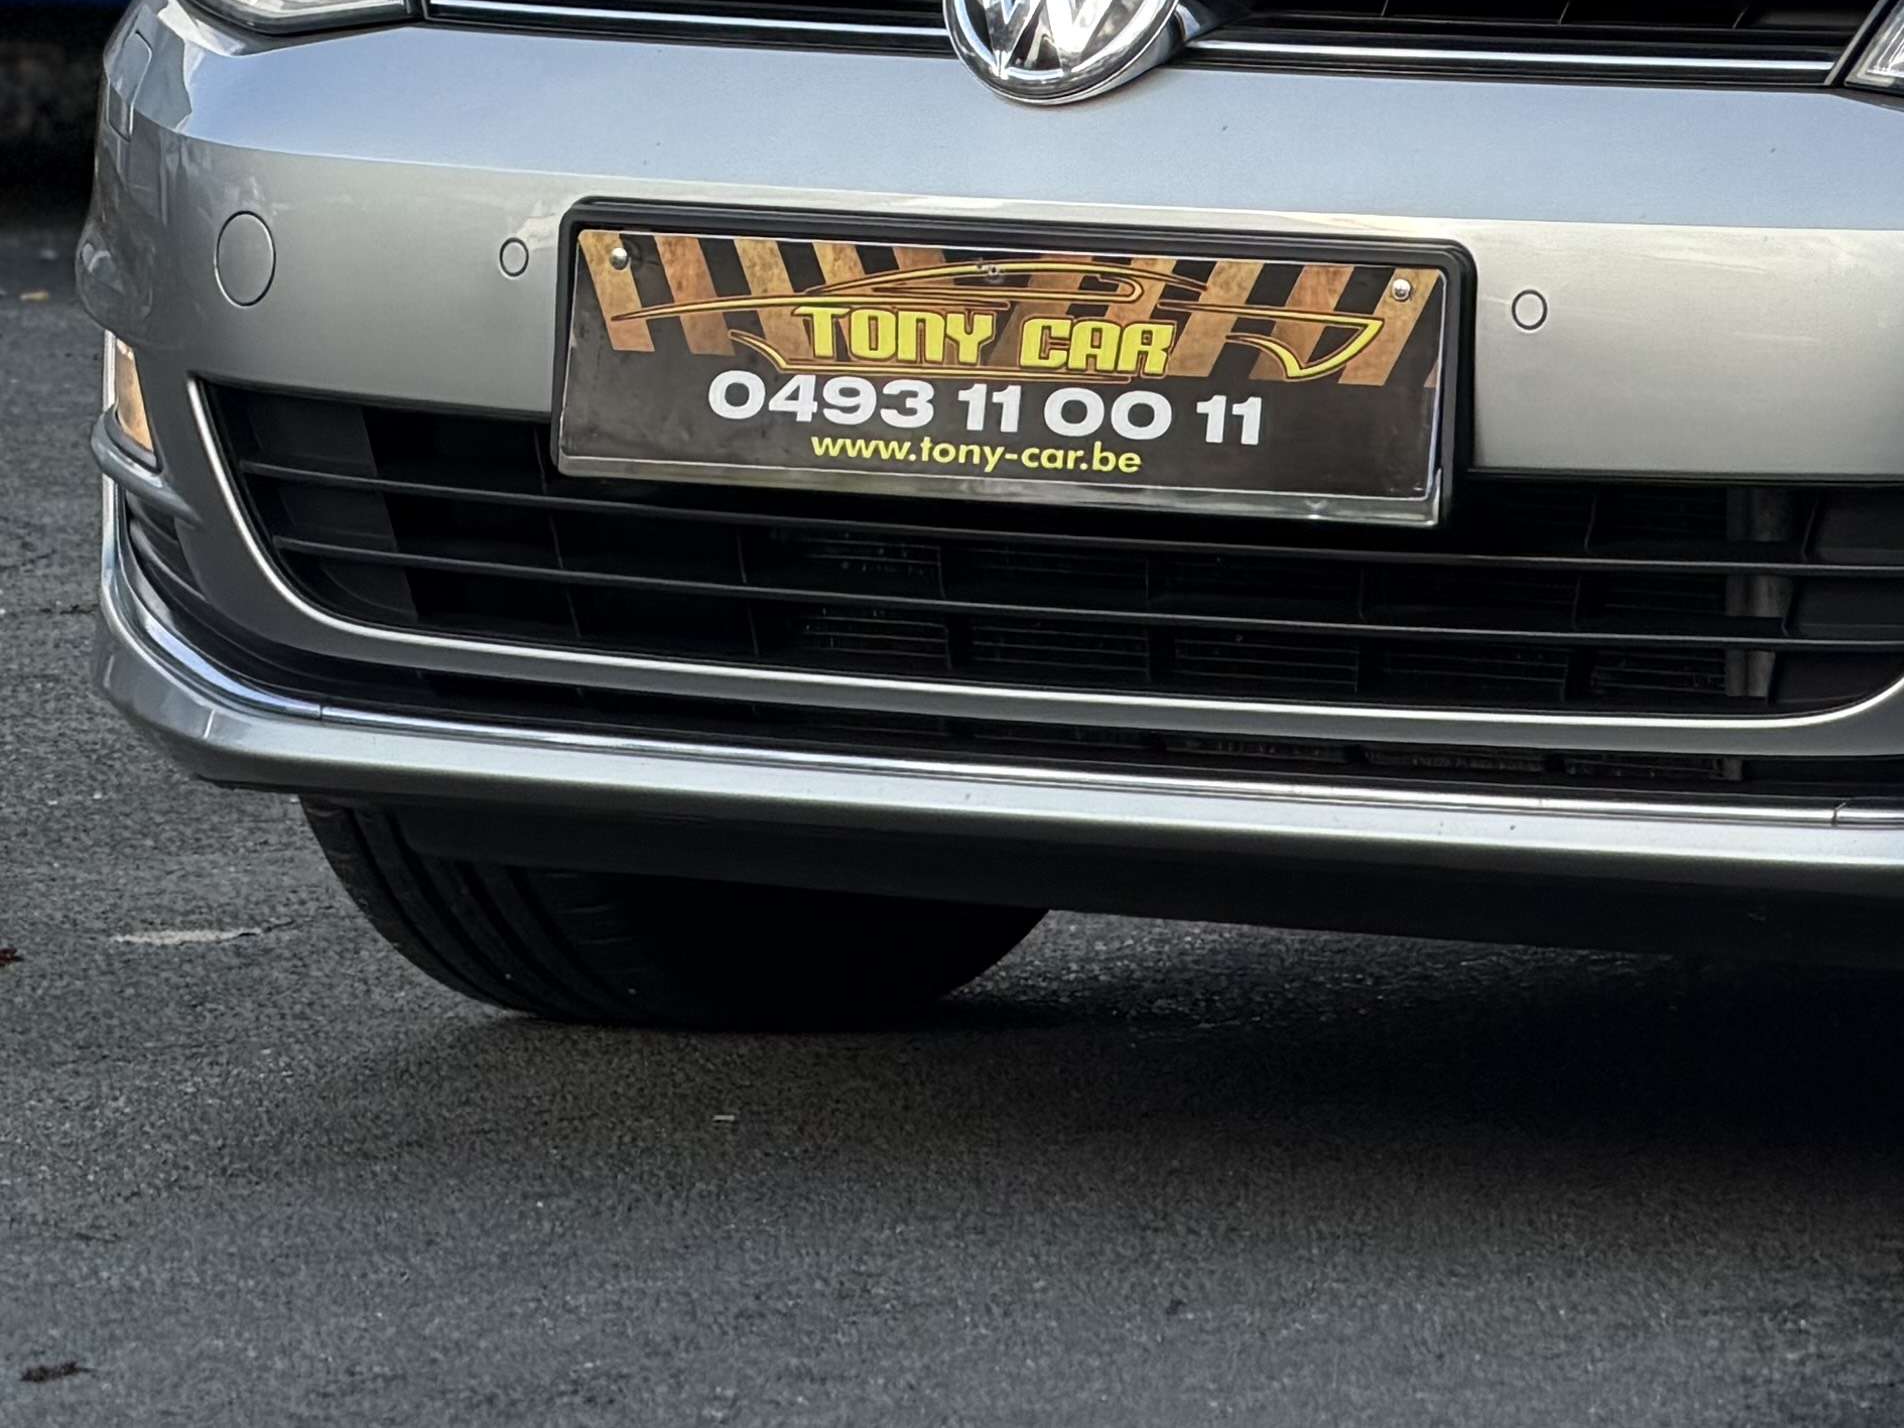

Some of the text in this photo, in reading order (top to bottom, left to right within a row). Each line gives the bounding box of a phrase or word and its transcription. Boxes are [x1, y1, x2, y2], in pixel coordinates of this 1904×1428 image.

[791, 302, 1178, 377] TONY CAR
[708, 369, 938, 430] 0493
[957, 384, 1022, 434] 11
[1196, 396, 1264, 446] 11
[810, 434, 1143, 474] www.tony-car.be
